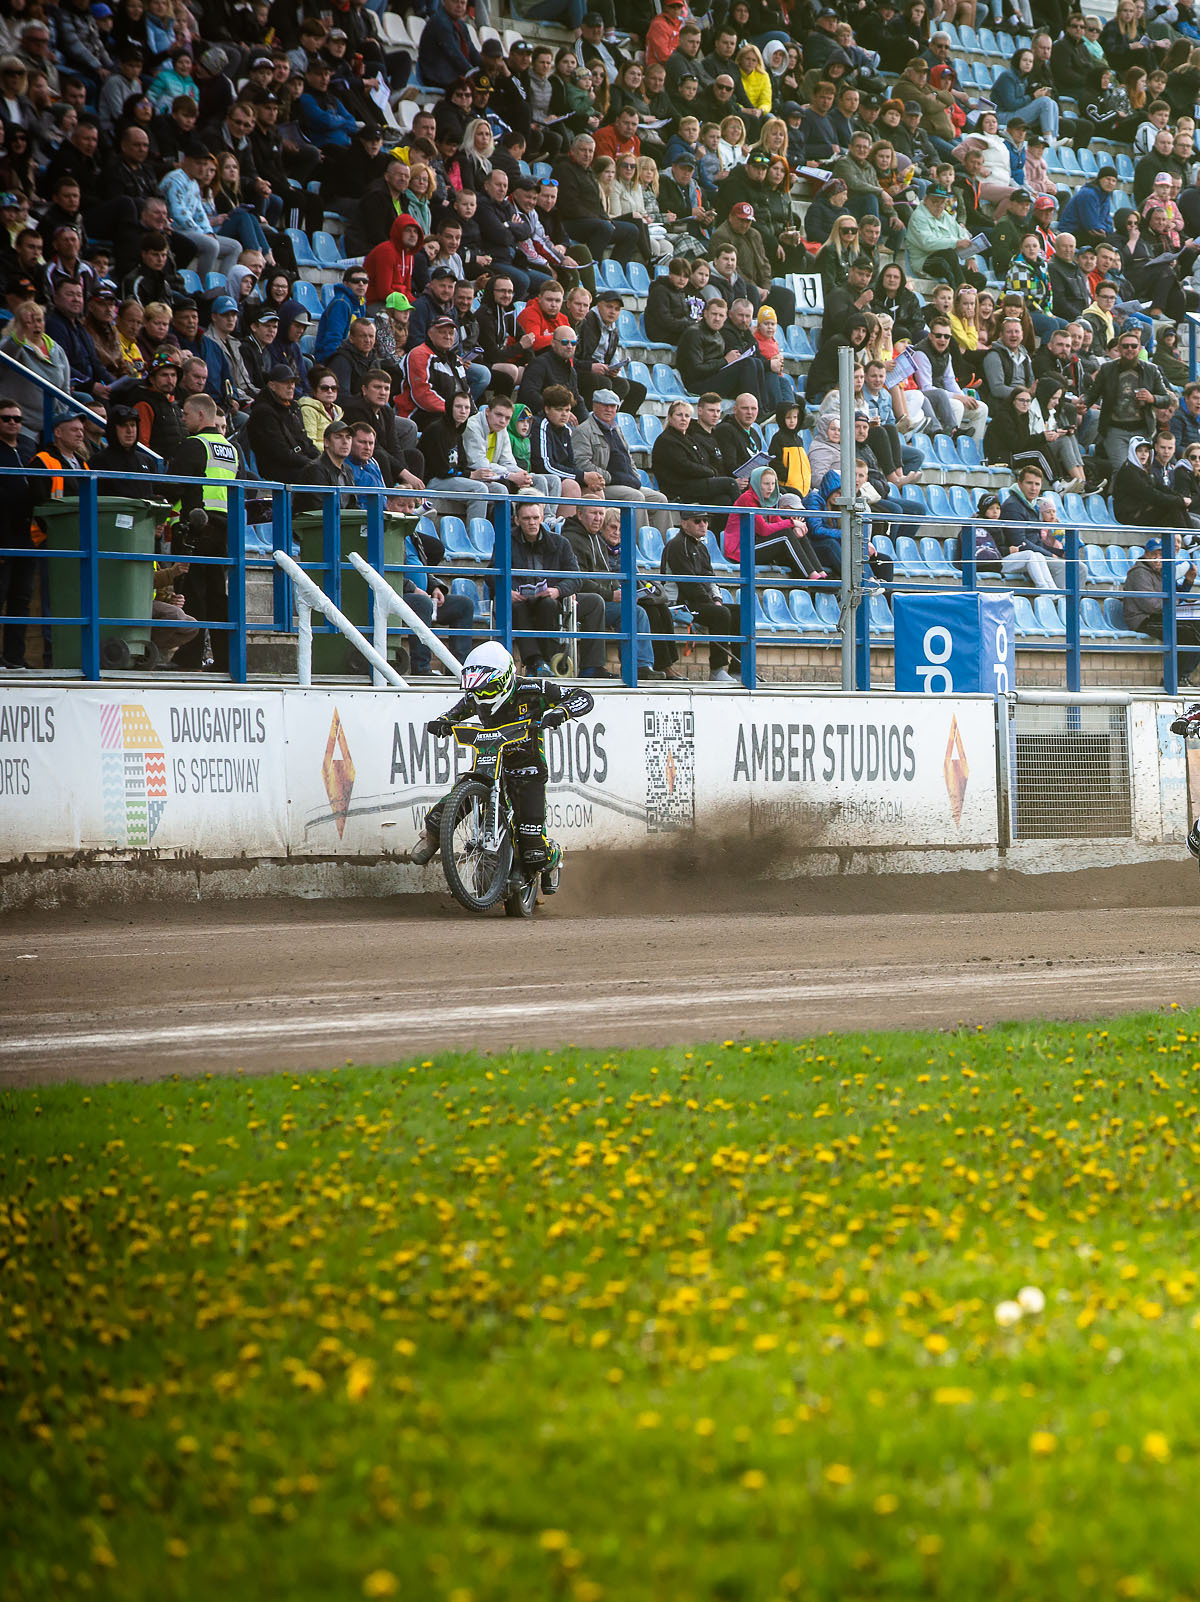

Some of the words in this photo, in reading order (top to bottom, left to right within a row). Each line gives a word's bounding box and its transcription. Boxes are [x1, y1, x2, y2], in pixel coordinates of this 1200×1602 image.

[170, 707, 266, 743] DAUGAVPILS
[733, 723, 816, 782] AMBER
[822, 723, 916, 782] STUDIOS
[172, 758, 187, 794] IS
[190, 758, 261, 794] SPEEDWAY
